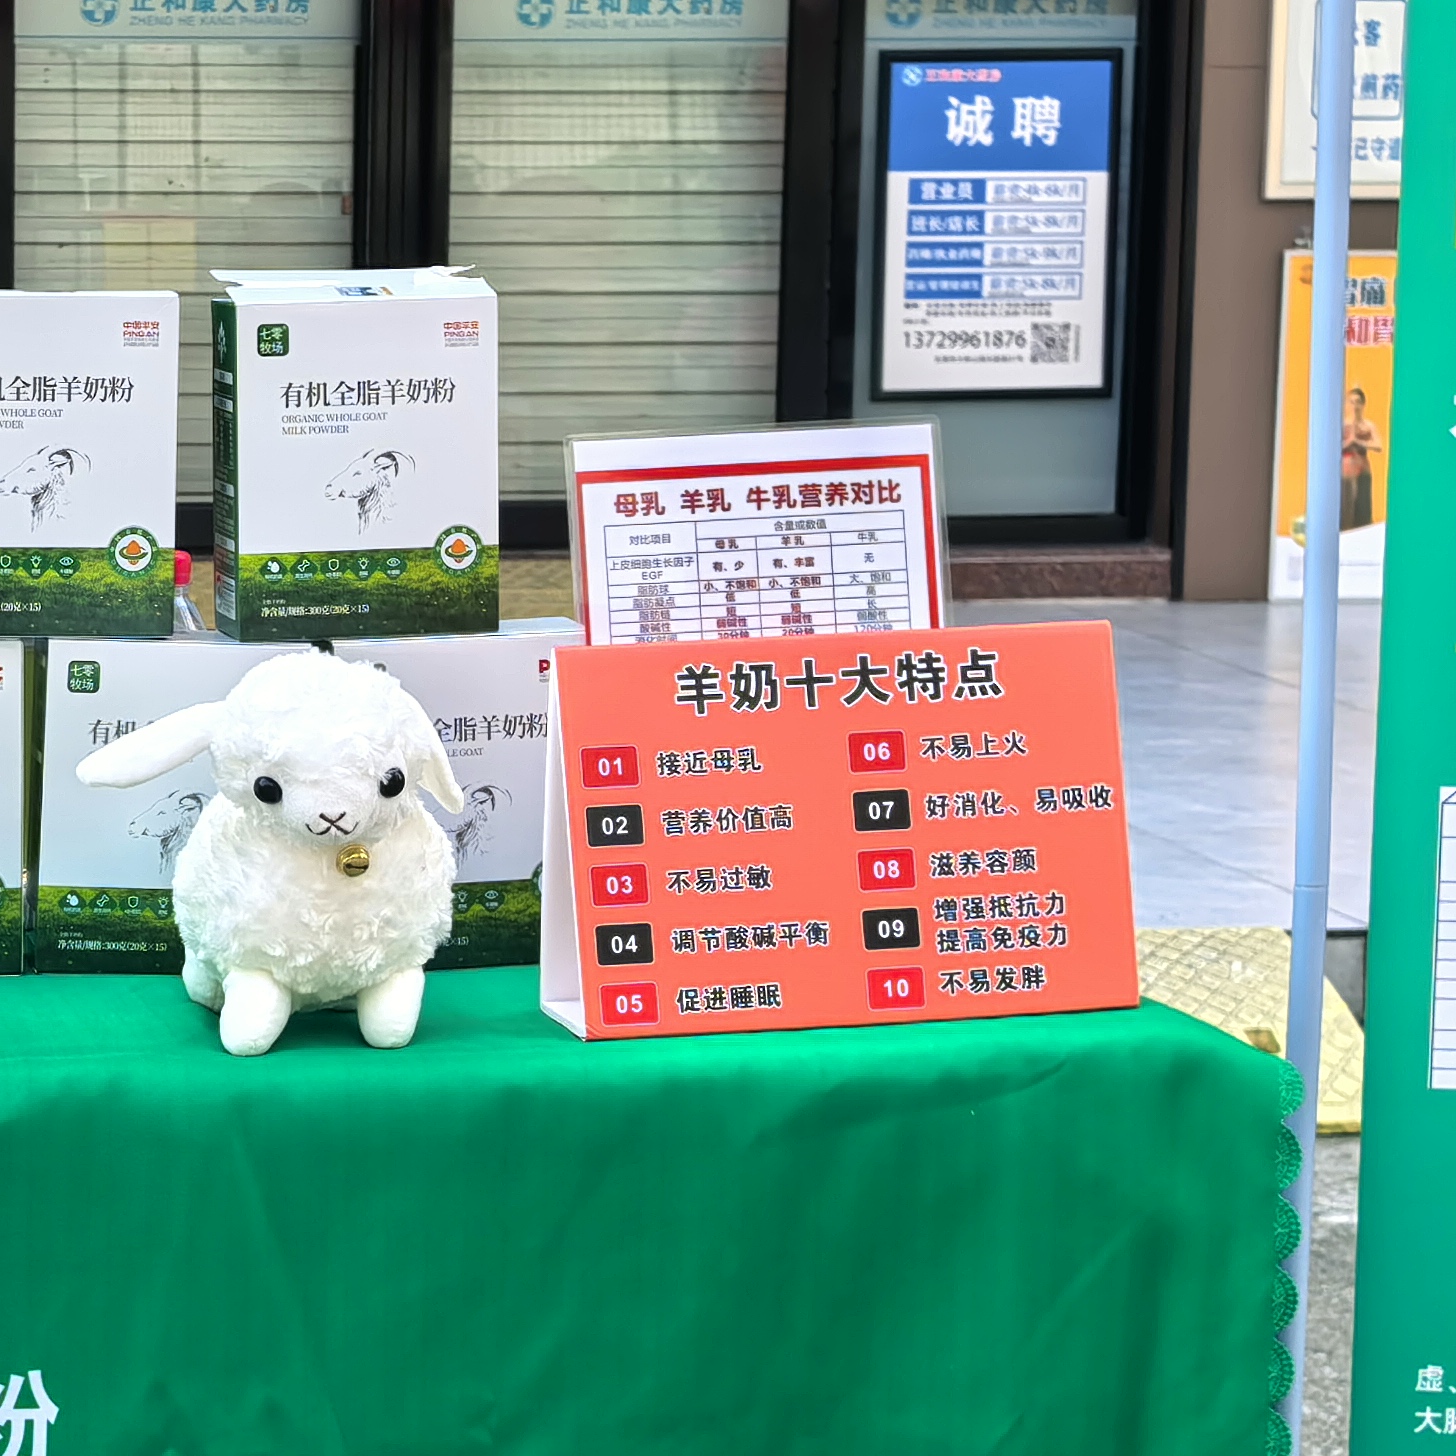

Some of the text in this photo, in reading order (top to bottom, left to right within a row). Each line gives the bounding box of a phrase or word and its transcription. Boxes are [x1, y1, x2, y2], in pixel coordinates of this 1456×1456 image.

[945, 95, 1062, 147] 诚聘
[920, 182, 974, 201] 营业员
[903, 330, 1027, 350] 13729961876
[280, 377, 456, 409] 有机全脂羊奶粉
[614, 479, 902, 517] 母乳 羊乳 牛乳营养对比
[629, 533, 671, 546] 对比项目
[676, 648, 1006, 716] 羊奶十大特点
[598, 731, 1026, 777] 01 接近母乳 06 不易上火
[602, 817, 629, 835] 02
[661, 804, 794, 836] 营养价值高
[868, 801, 895, 819] 07
[606, 848, 1037, 894] 03 不易过敏 08 滋养容颜
[933, 893, 1066, 922] 增强抵抗力
[611, 920, 1068, 954] 04 调节酸碱平衡 09 提高免疫力
[616, 965, 1046, 1014] 05 促进睡眠 10 不易发胖
